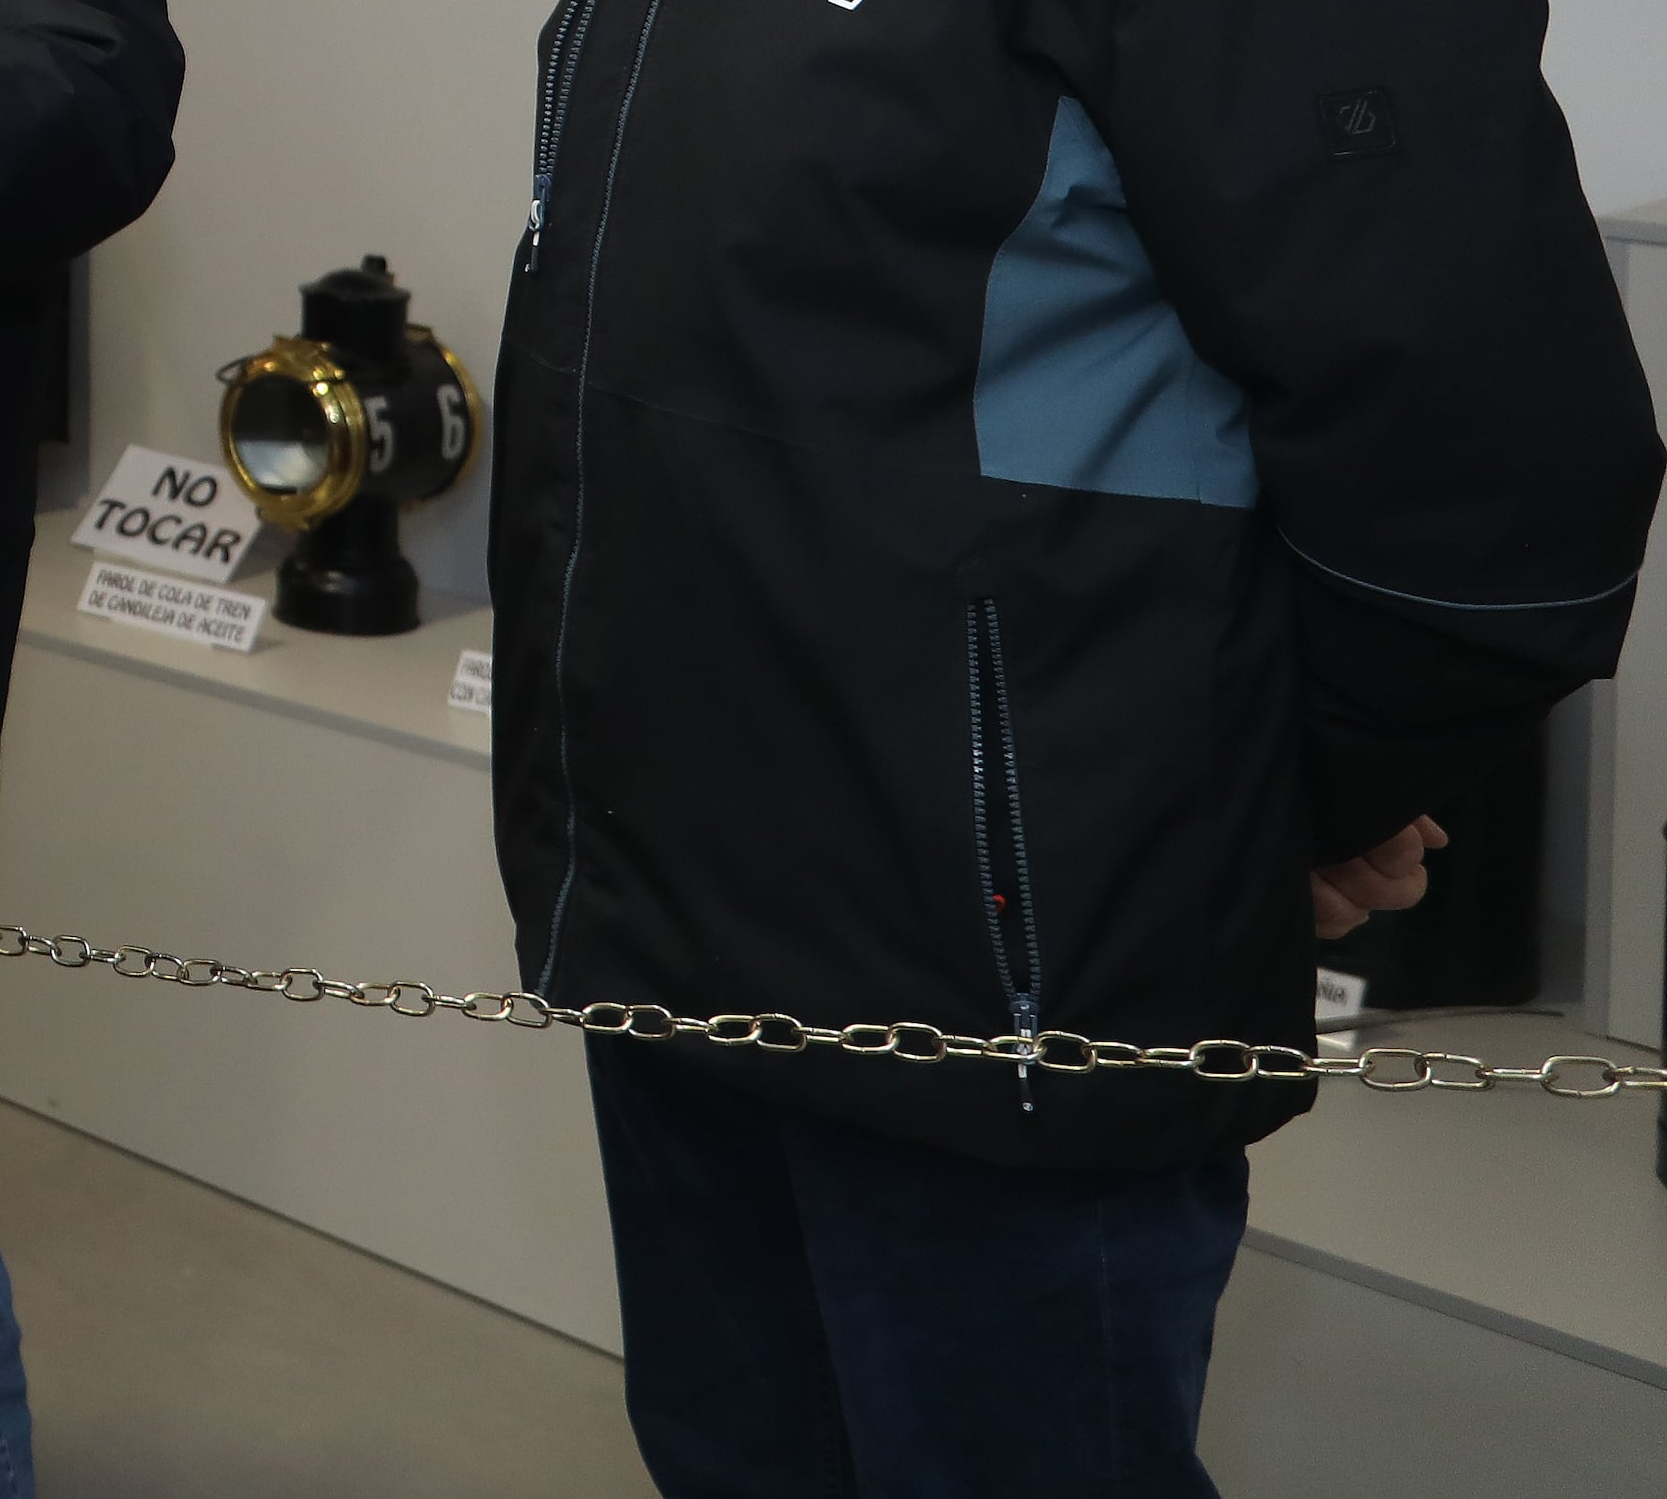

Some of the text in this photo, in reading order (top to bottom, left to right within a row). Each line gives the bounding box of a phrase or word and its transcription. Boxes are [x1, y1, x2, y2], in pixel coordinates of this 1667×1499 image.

[365, 384, 466, 472] 5 6
[151, 465, 218, 507] NO
[94, 498, 242, 564] TOCAR
[88, 589, 107, 608] DE
[176, 612, 196, 630] DE
[196, 617, 245, 642] ACEITE
[96, 569, 251, 620] FAROL DE COLA DE TREN
